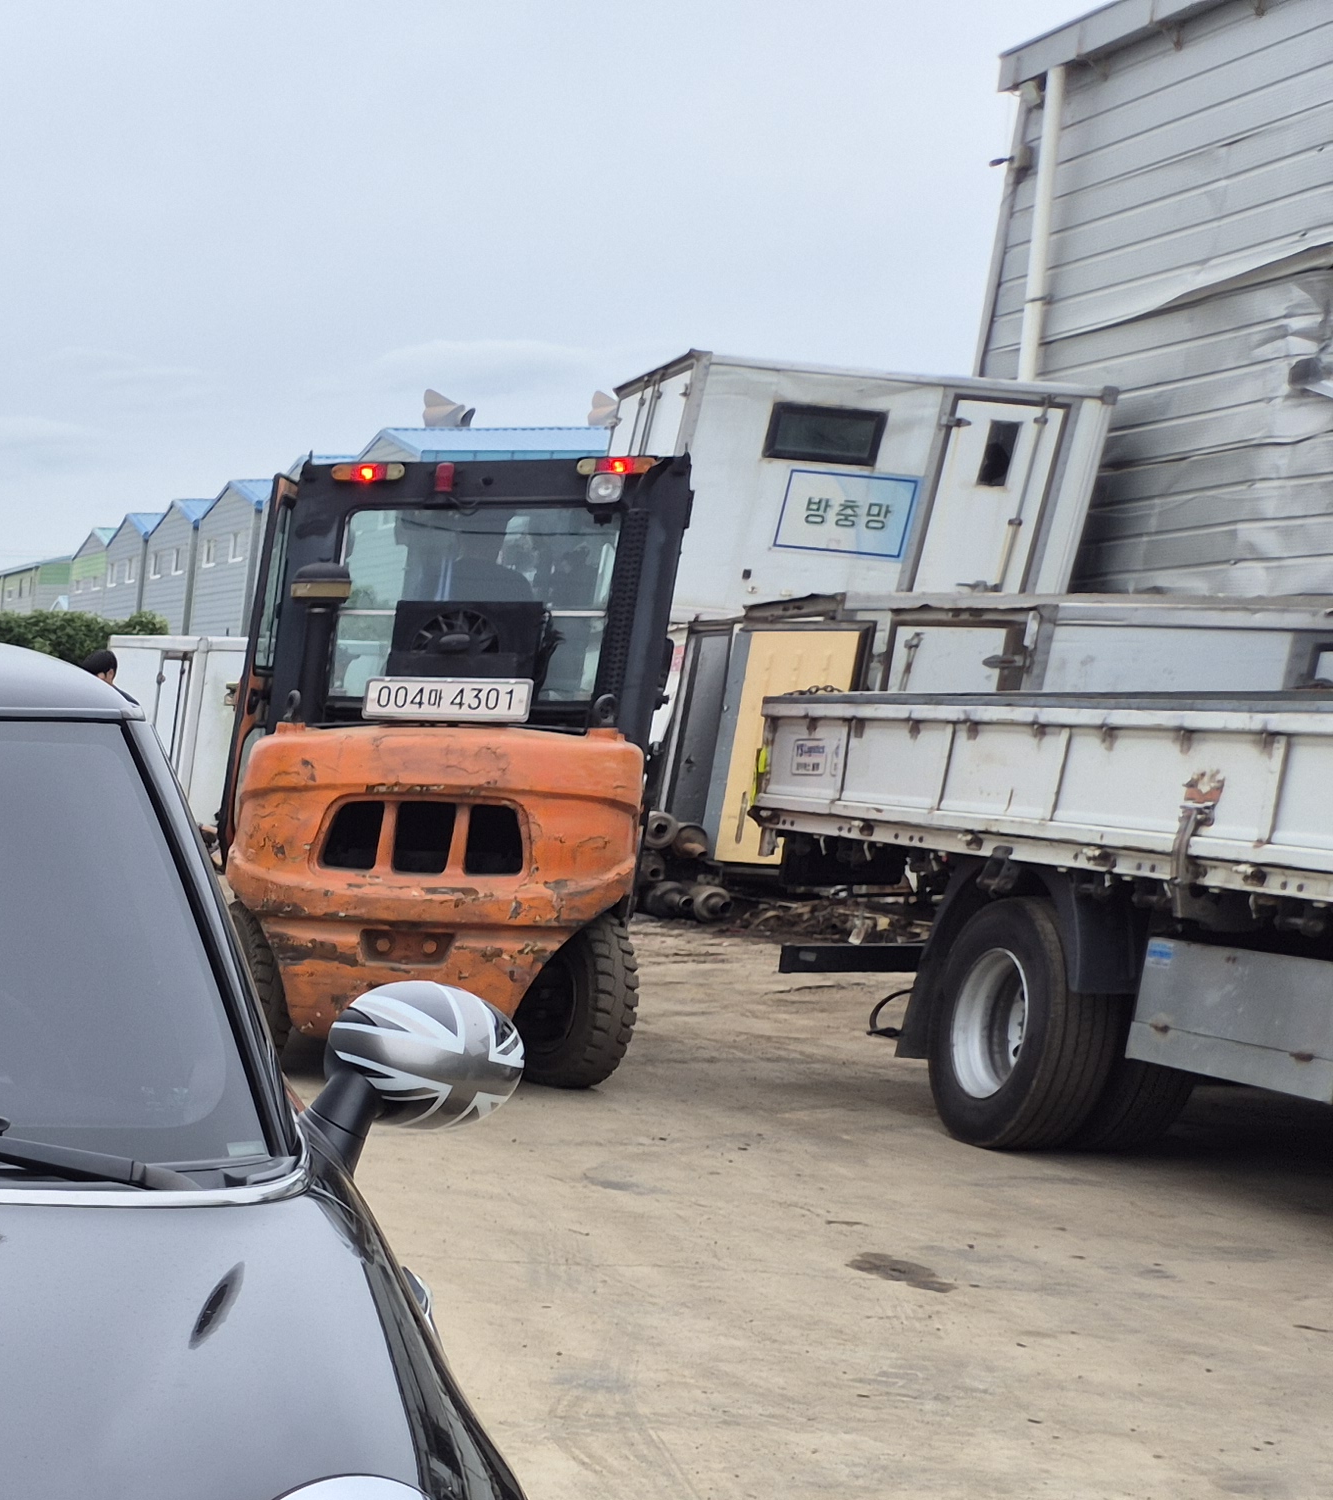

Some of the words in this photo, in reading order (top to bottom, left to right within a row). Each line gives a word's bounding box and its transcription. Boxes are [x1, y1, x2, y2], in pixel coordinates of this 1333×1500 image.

[804, 496, 893, 531] 방충망
[376, 685, 443, 709] 004마
[450, 687, 515, 711] 4301
